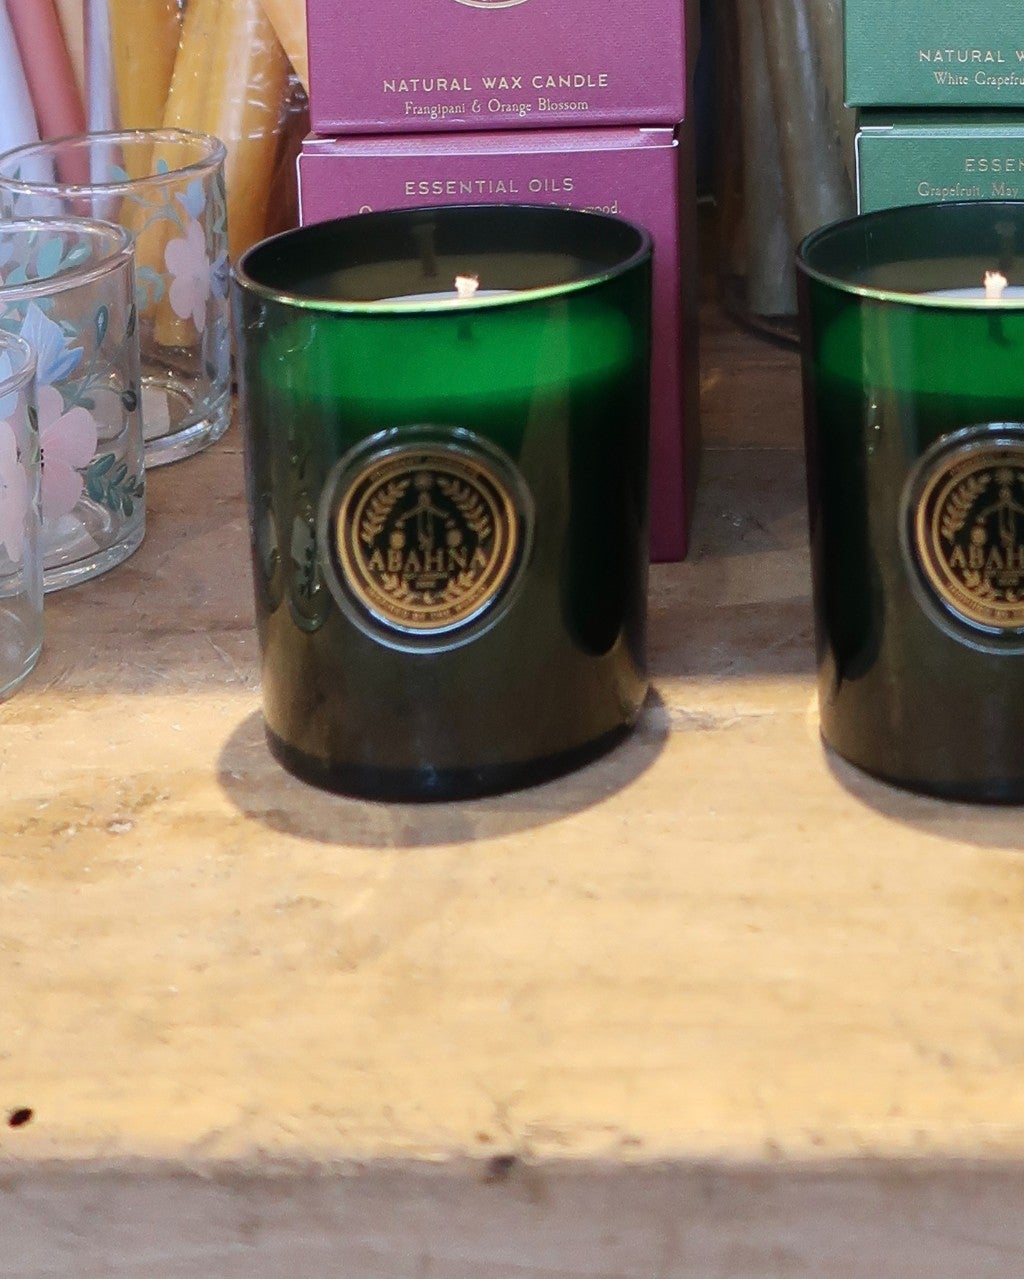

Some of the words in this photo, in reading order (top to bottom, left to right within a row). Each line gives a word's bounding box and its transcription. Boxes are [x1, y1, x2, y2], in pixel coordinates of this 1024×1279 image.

[919, 50, 1006, 63] NATURAL
[383, 78, 472, 93] NATURAL
[482, 76, 522, 90] WAX
[532, 74, 608, 89] CANDLE
[933, 71, 969, 85] White
[404, 101, 466, 118] Frangipani
[471, 99, 481, 113] &
[487, 98, 532, 116] Orange
[538, 97, 589, 112] Blossom
[405, 179, 519, 195] ESSENTIAL
[528, 177, 574, 192] OILS
[991, 182, 1019, 199] May
